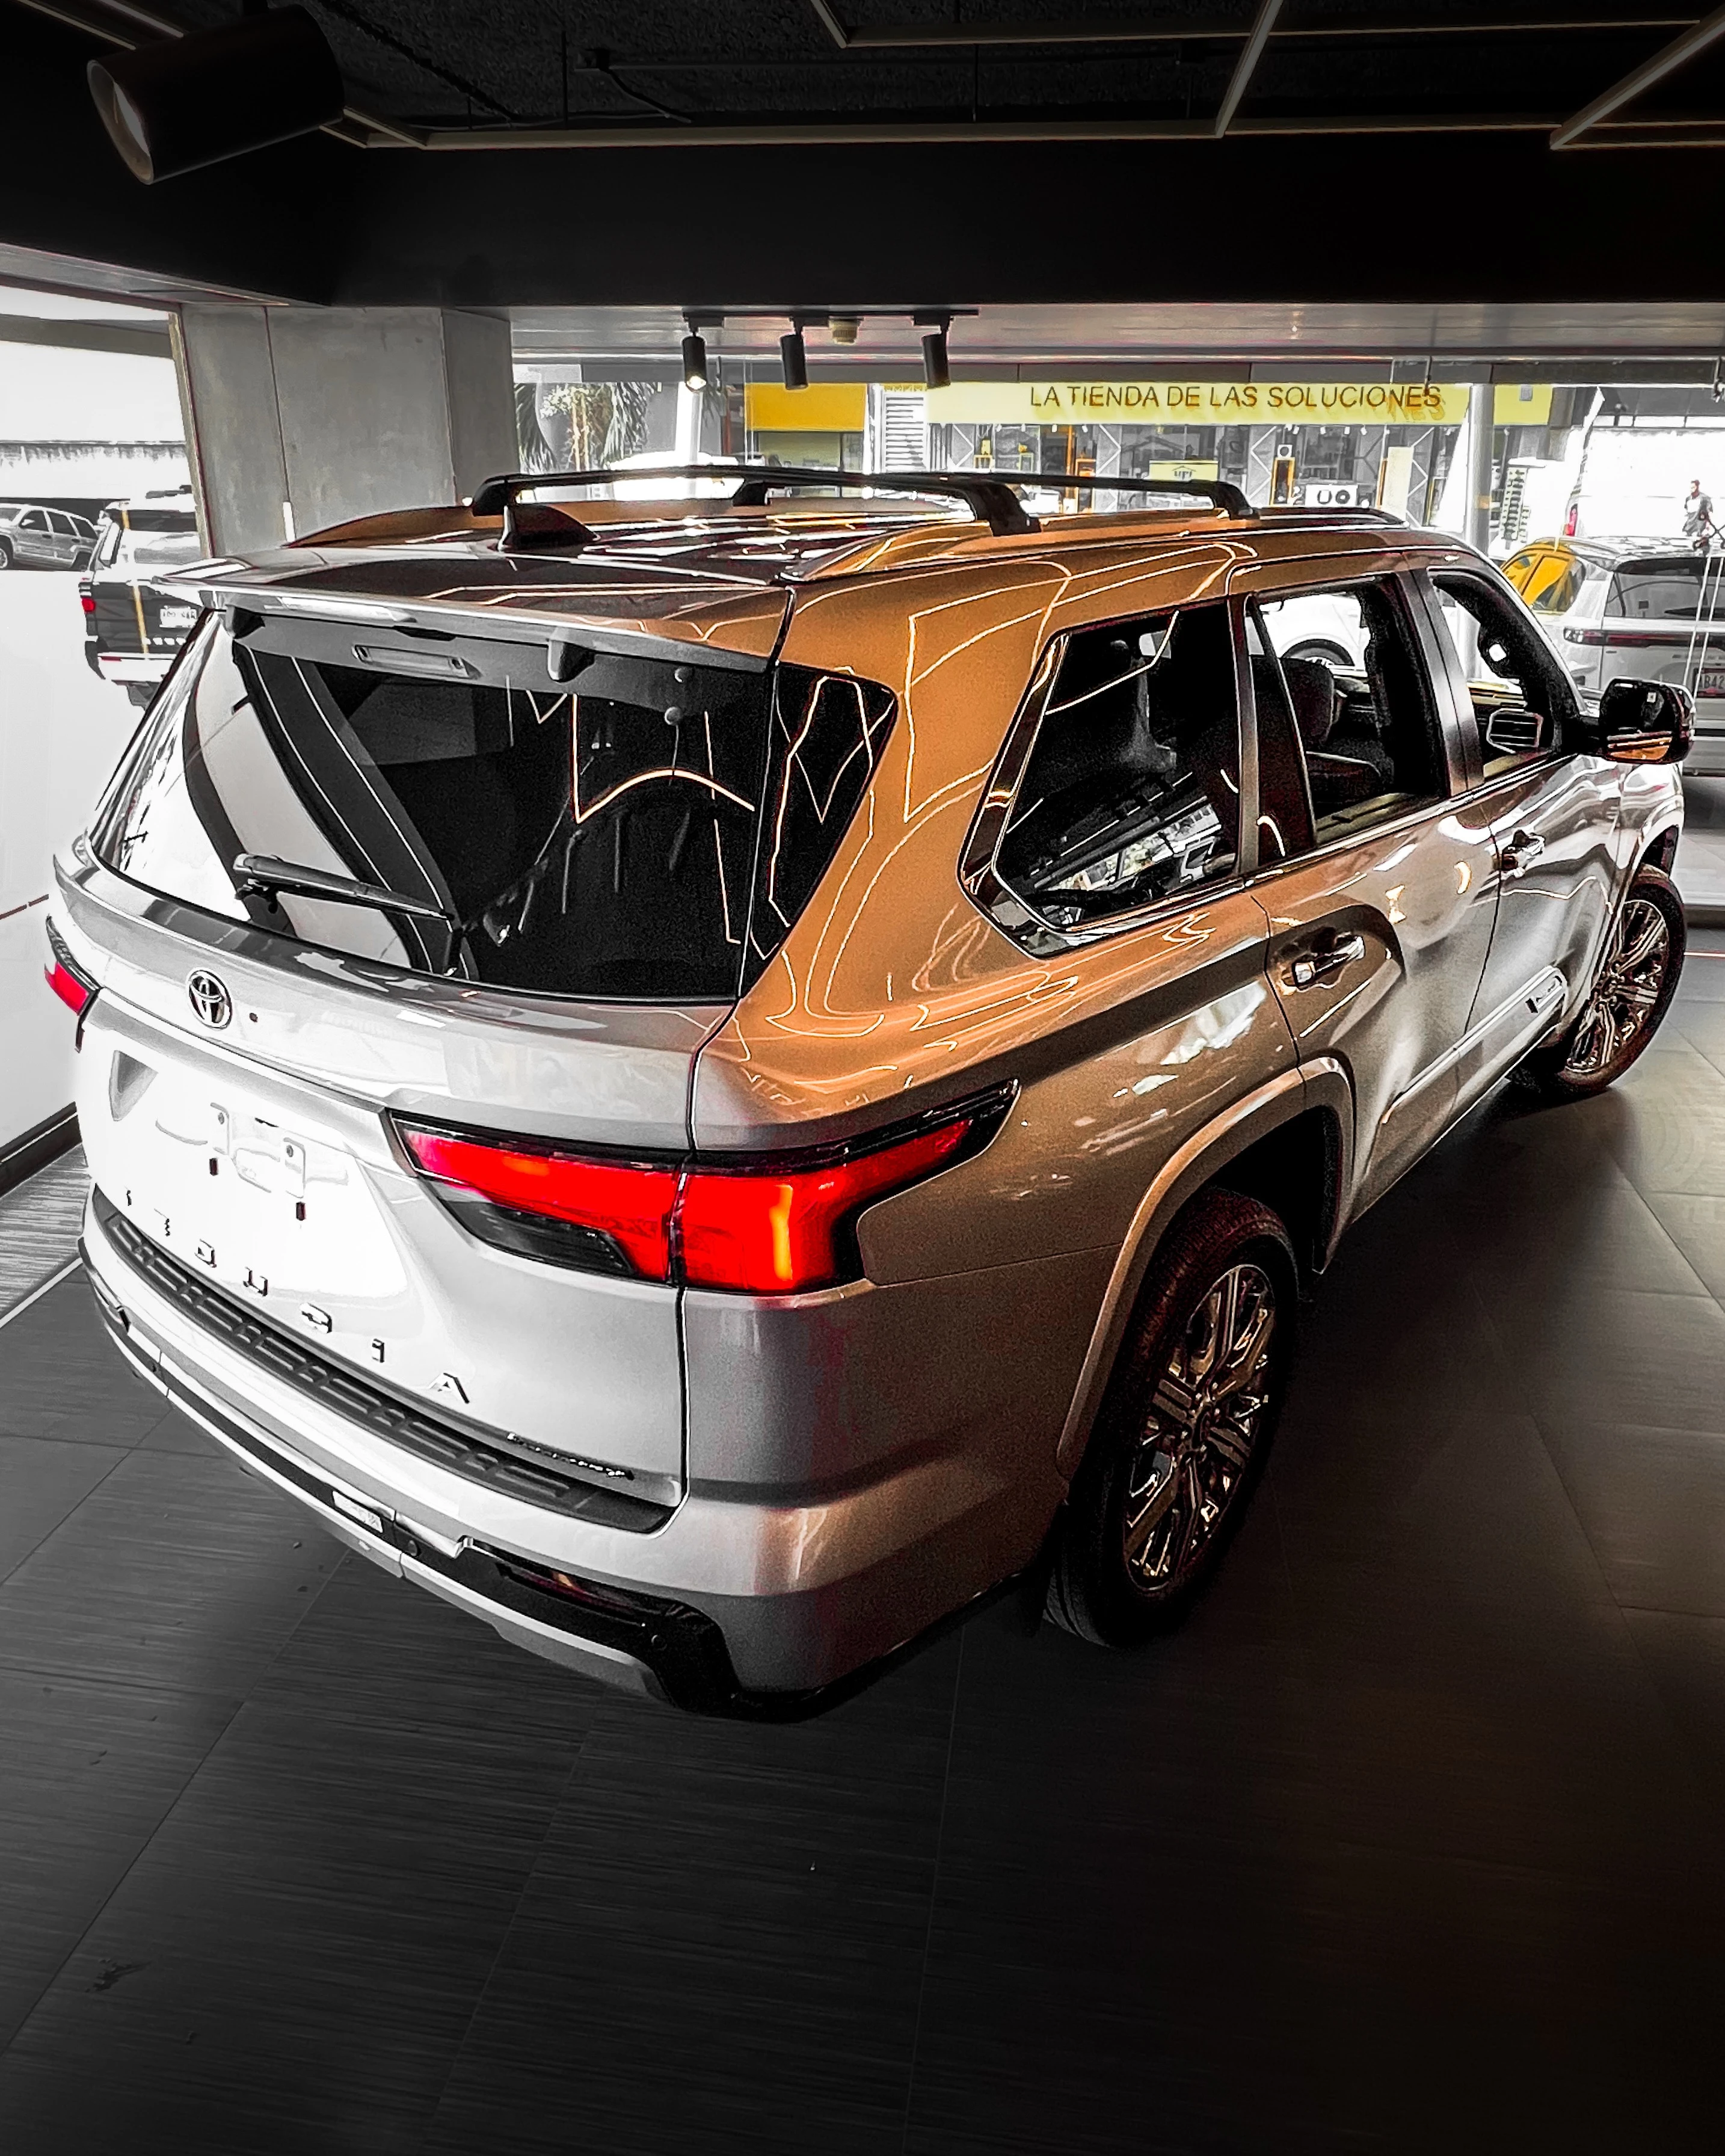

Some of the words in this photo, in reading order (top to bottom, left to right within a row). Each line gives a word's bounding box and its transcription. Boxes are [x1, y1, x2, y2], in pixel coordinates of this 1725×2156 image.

[1031, 386, 1060, 407] LA
[1067, 386, 1159, 407] TIENDA
[1167, 386, 1200, 407] DE
[1210, 386, 1258, 407] LAS
[1267, 386, 1441, 407] SOLUCIONES
